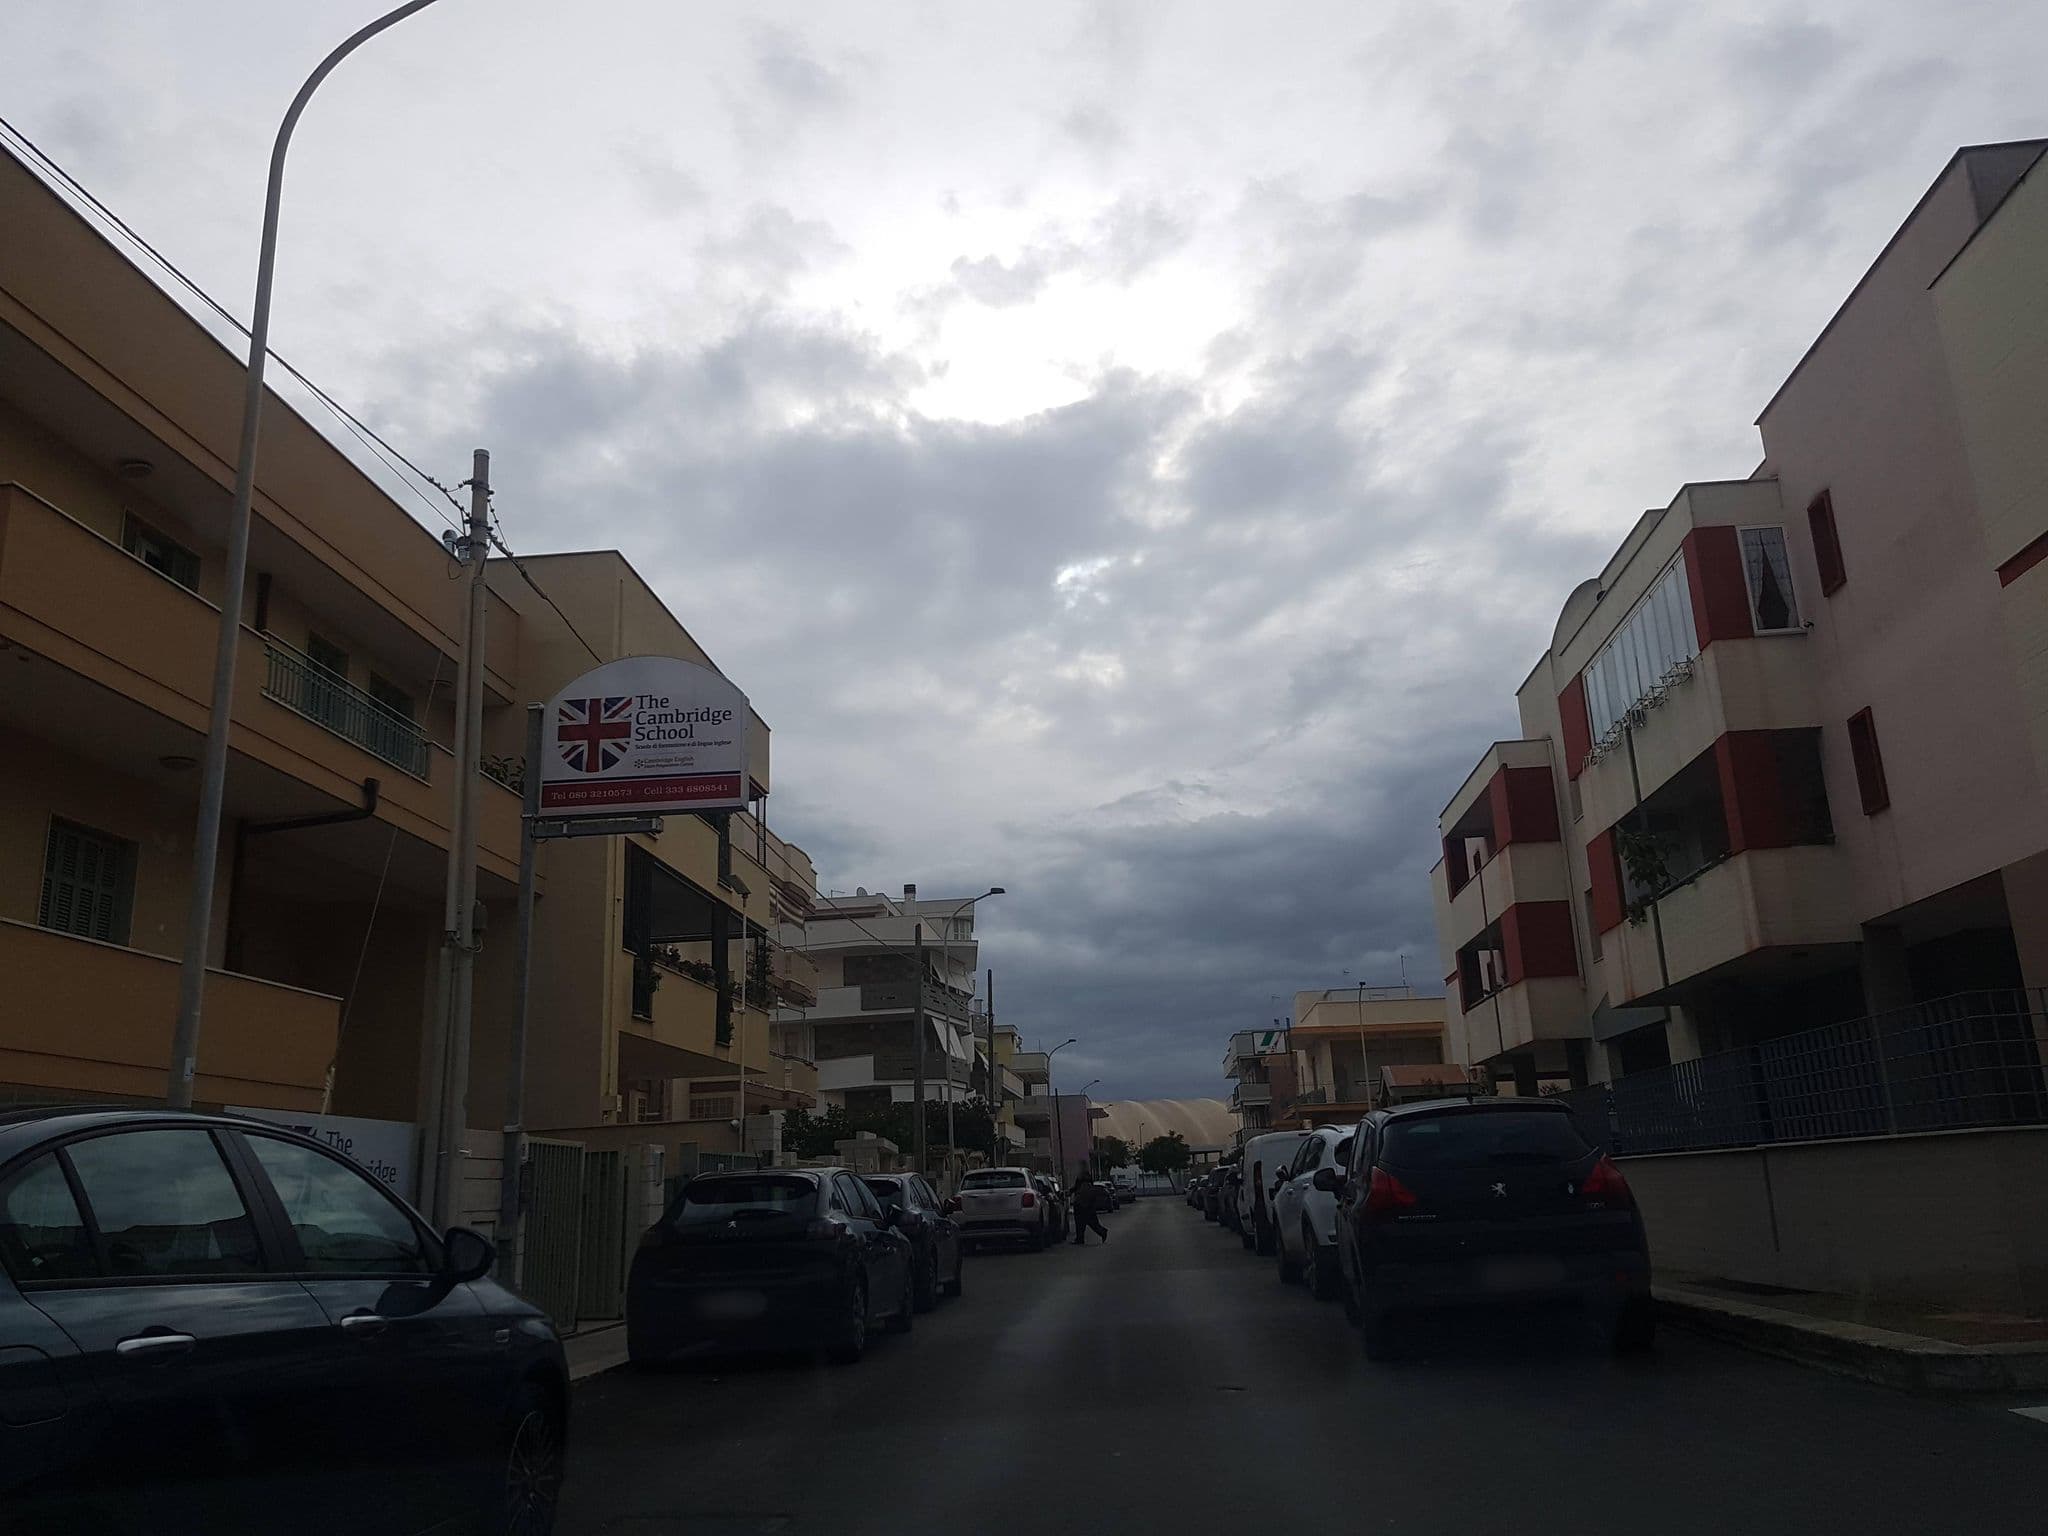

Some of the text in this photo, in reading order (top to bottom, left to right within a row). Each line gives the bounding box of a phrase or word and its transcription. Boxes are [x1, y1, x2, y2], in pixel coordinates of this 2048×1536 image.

[635, 695, 669, 709] The
[636, 707, 732, 725] Cambridge
[635, 724, 694, 741] School
[551, 792, 566, 800] Tel
[568, 791, 588, 800] 080
[643, 786, 664, 795] Cell
[326, 1131, 353, 1155] The
